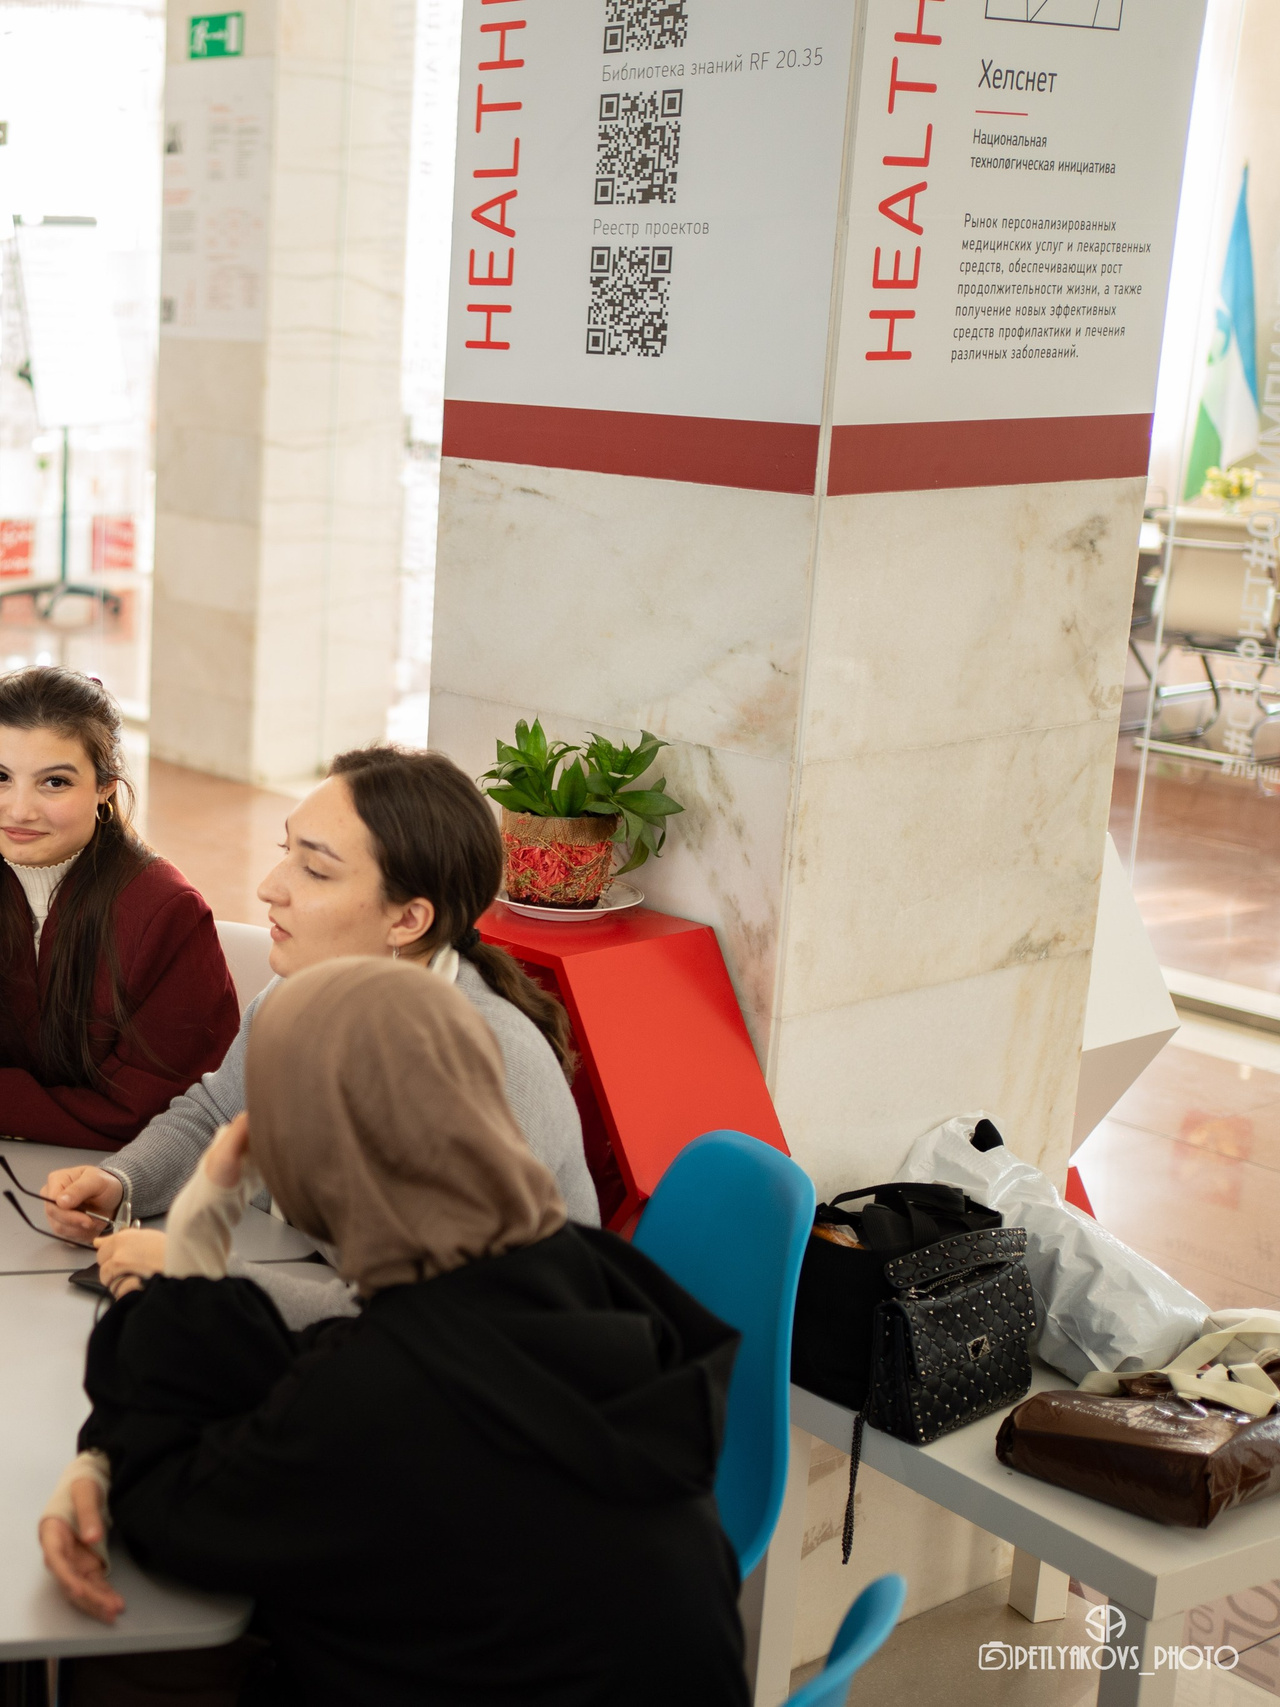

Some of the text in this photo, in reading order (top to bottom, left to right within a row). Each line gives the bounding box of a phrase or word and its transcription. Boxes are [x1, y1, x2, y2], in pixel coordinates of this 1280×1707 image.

[602, 46, 825, 83] Библиотека знаний RF 20.35
[977, 58, 1058, 94] Хелснет
[972, 128, 1048, 149] Национальная
[465, 0, 527, 351] HEALTH
[1057, 160, 1117, 176] инициатива
[592, 218, 710, 238] Реестр проектов
[963, 212, 1117, 234] Рынок персонализированных
[961, 239, 1152, 255] медицинских услуг и лекарственных
[959, 258, 1123, 276] средств, обеспечивающих рост
[956, 281, 1143, 297] продолжительности жизни, а также
[954, 303, 1117, 319] получение новых эффективных
[952, 325, 1126, 341] средств профилактики и лечения
[950, 344, 1080, 364] различных заболеваний.
